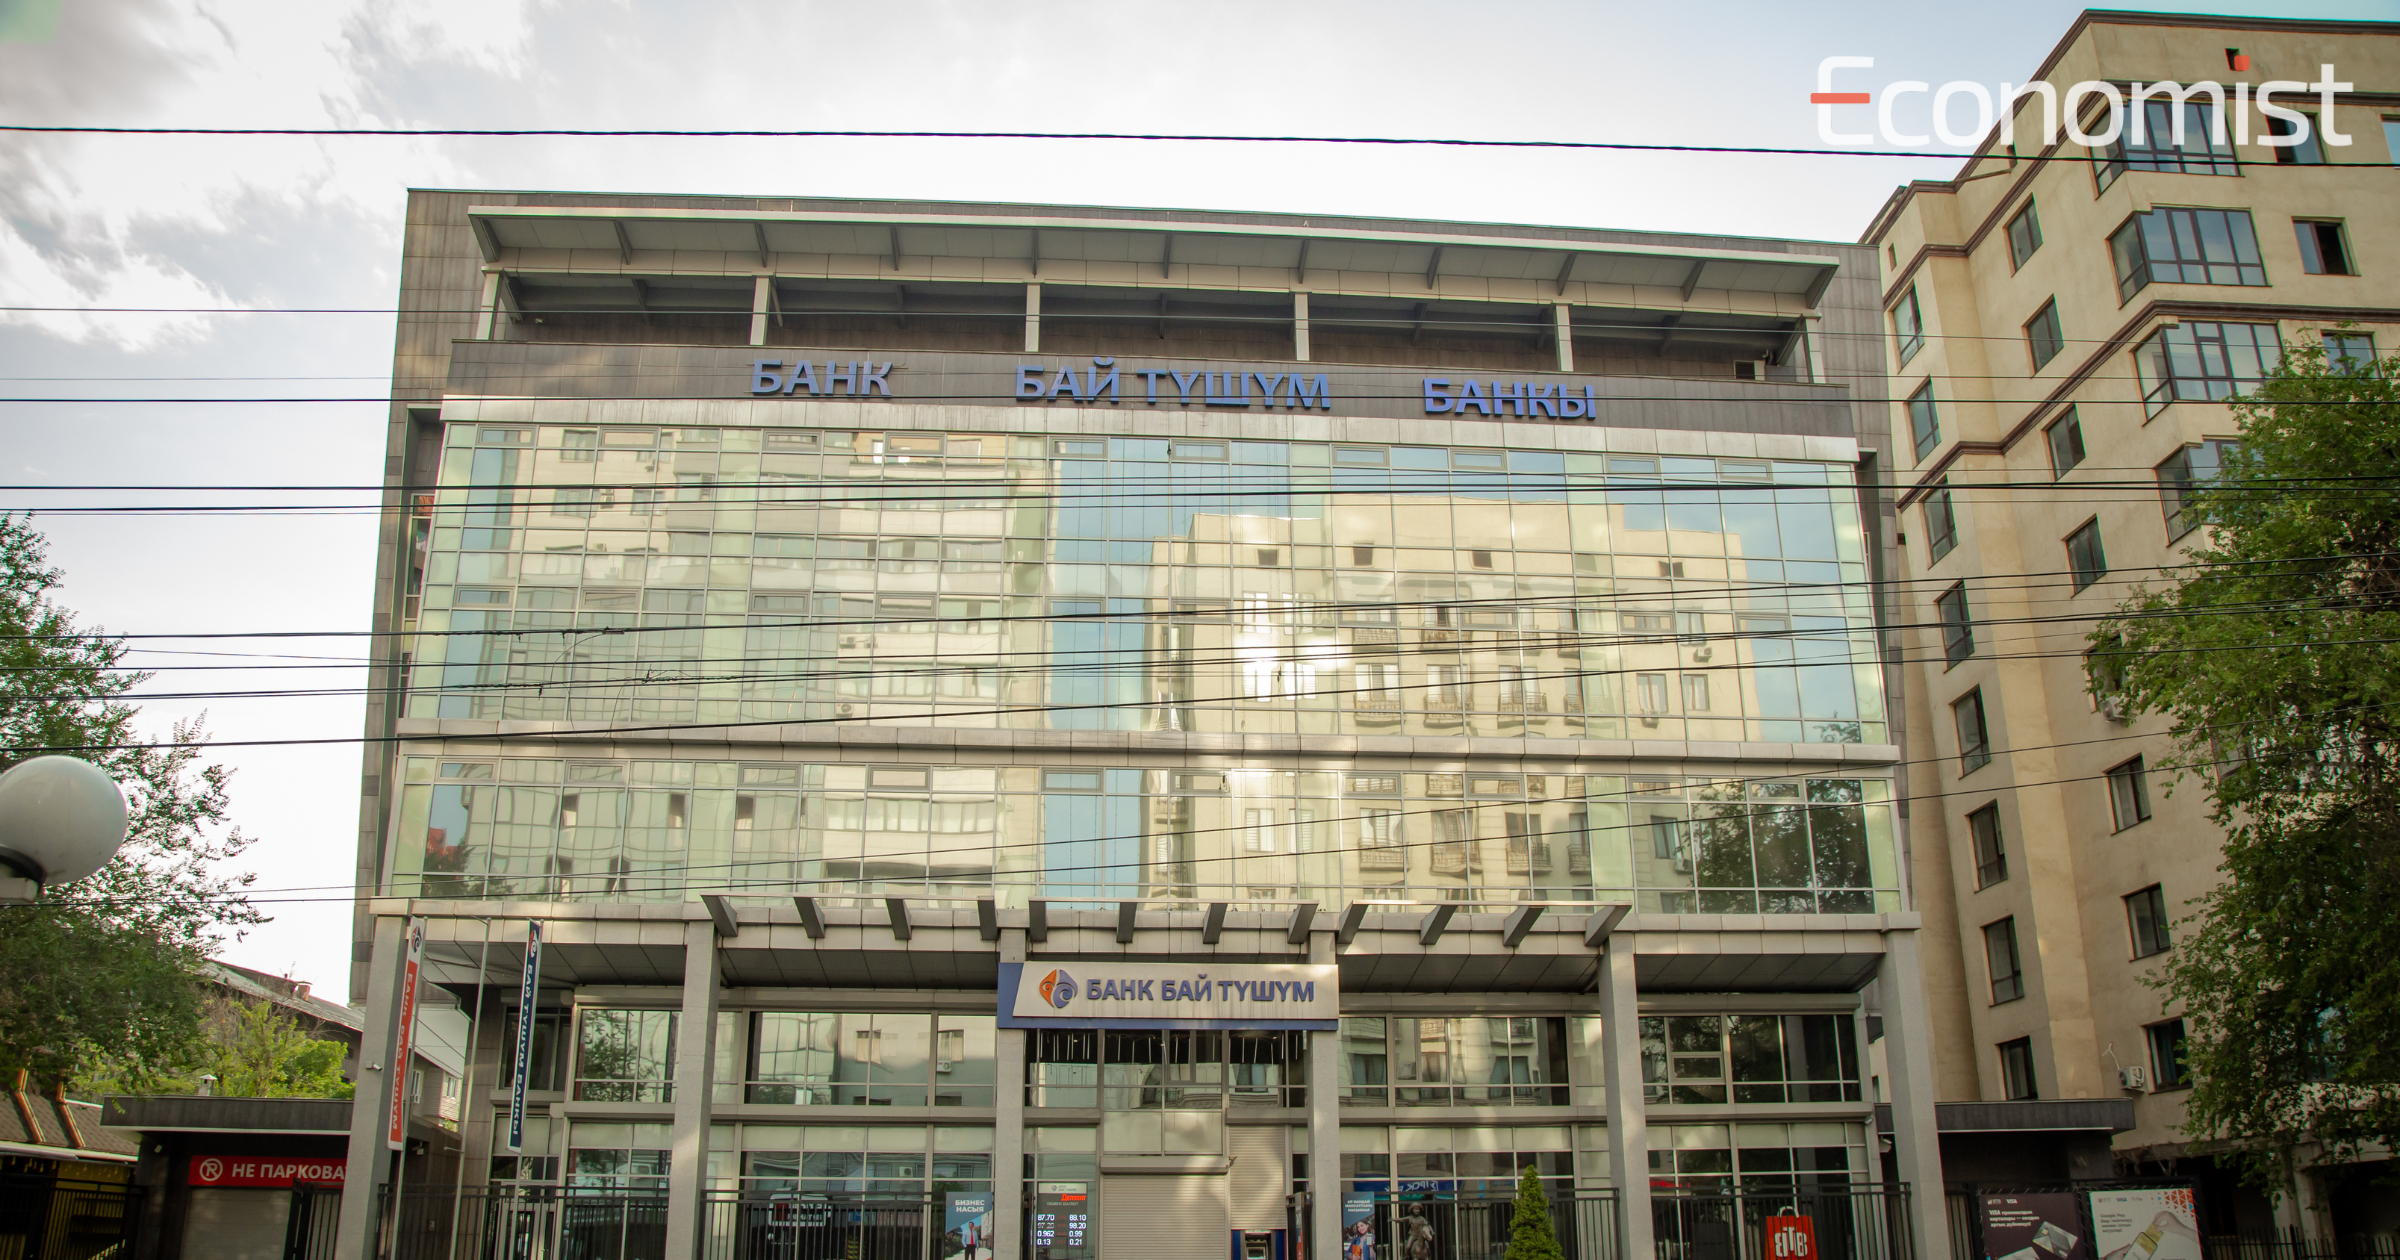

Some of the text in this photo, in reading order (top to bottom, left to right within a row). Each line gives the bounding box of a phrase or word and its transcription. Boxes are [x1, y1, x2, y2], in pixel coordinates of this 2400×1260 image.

[751, 359, 893, 397] БАНК
[1016, 356, 1120, 404] БАЙ
[1423, 378, 1597, 420] БАНКЫ
[402, 973, 414, 1017] БАНК
[525, 965, 534, 999] БАЙ
[1087, 978, 1154, 1001] БАНК
[1161, 974, 1212, 1002] БАЙ
[397, 1025, 405, 1059] БАЙ
[512, 1073, 522, 1135] БАНКЫ
[232, 1163, 348, 1180] НЕ ПАРКОВА
